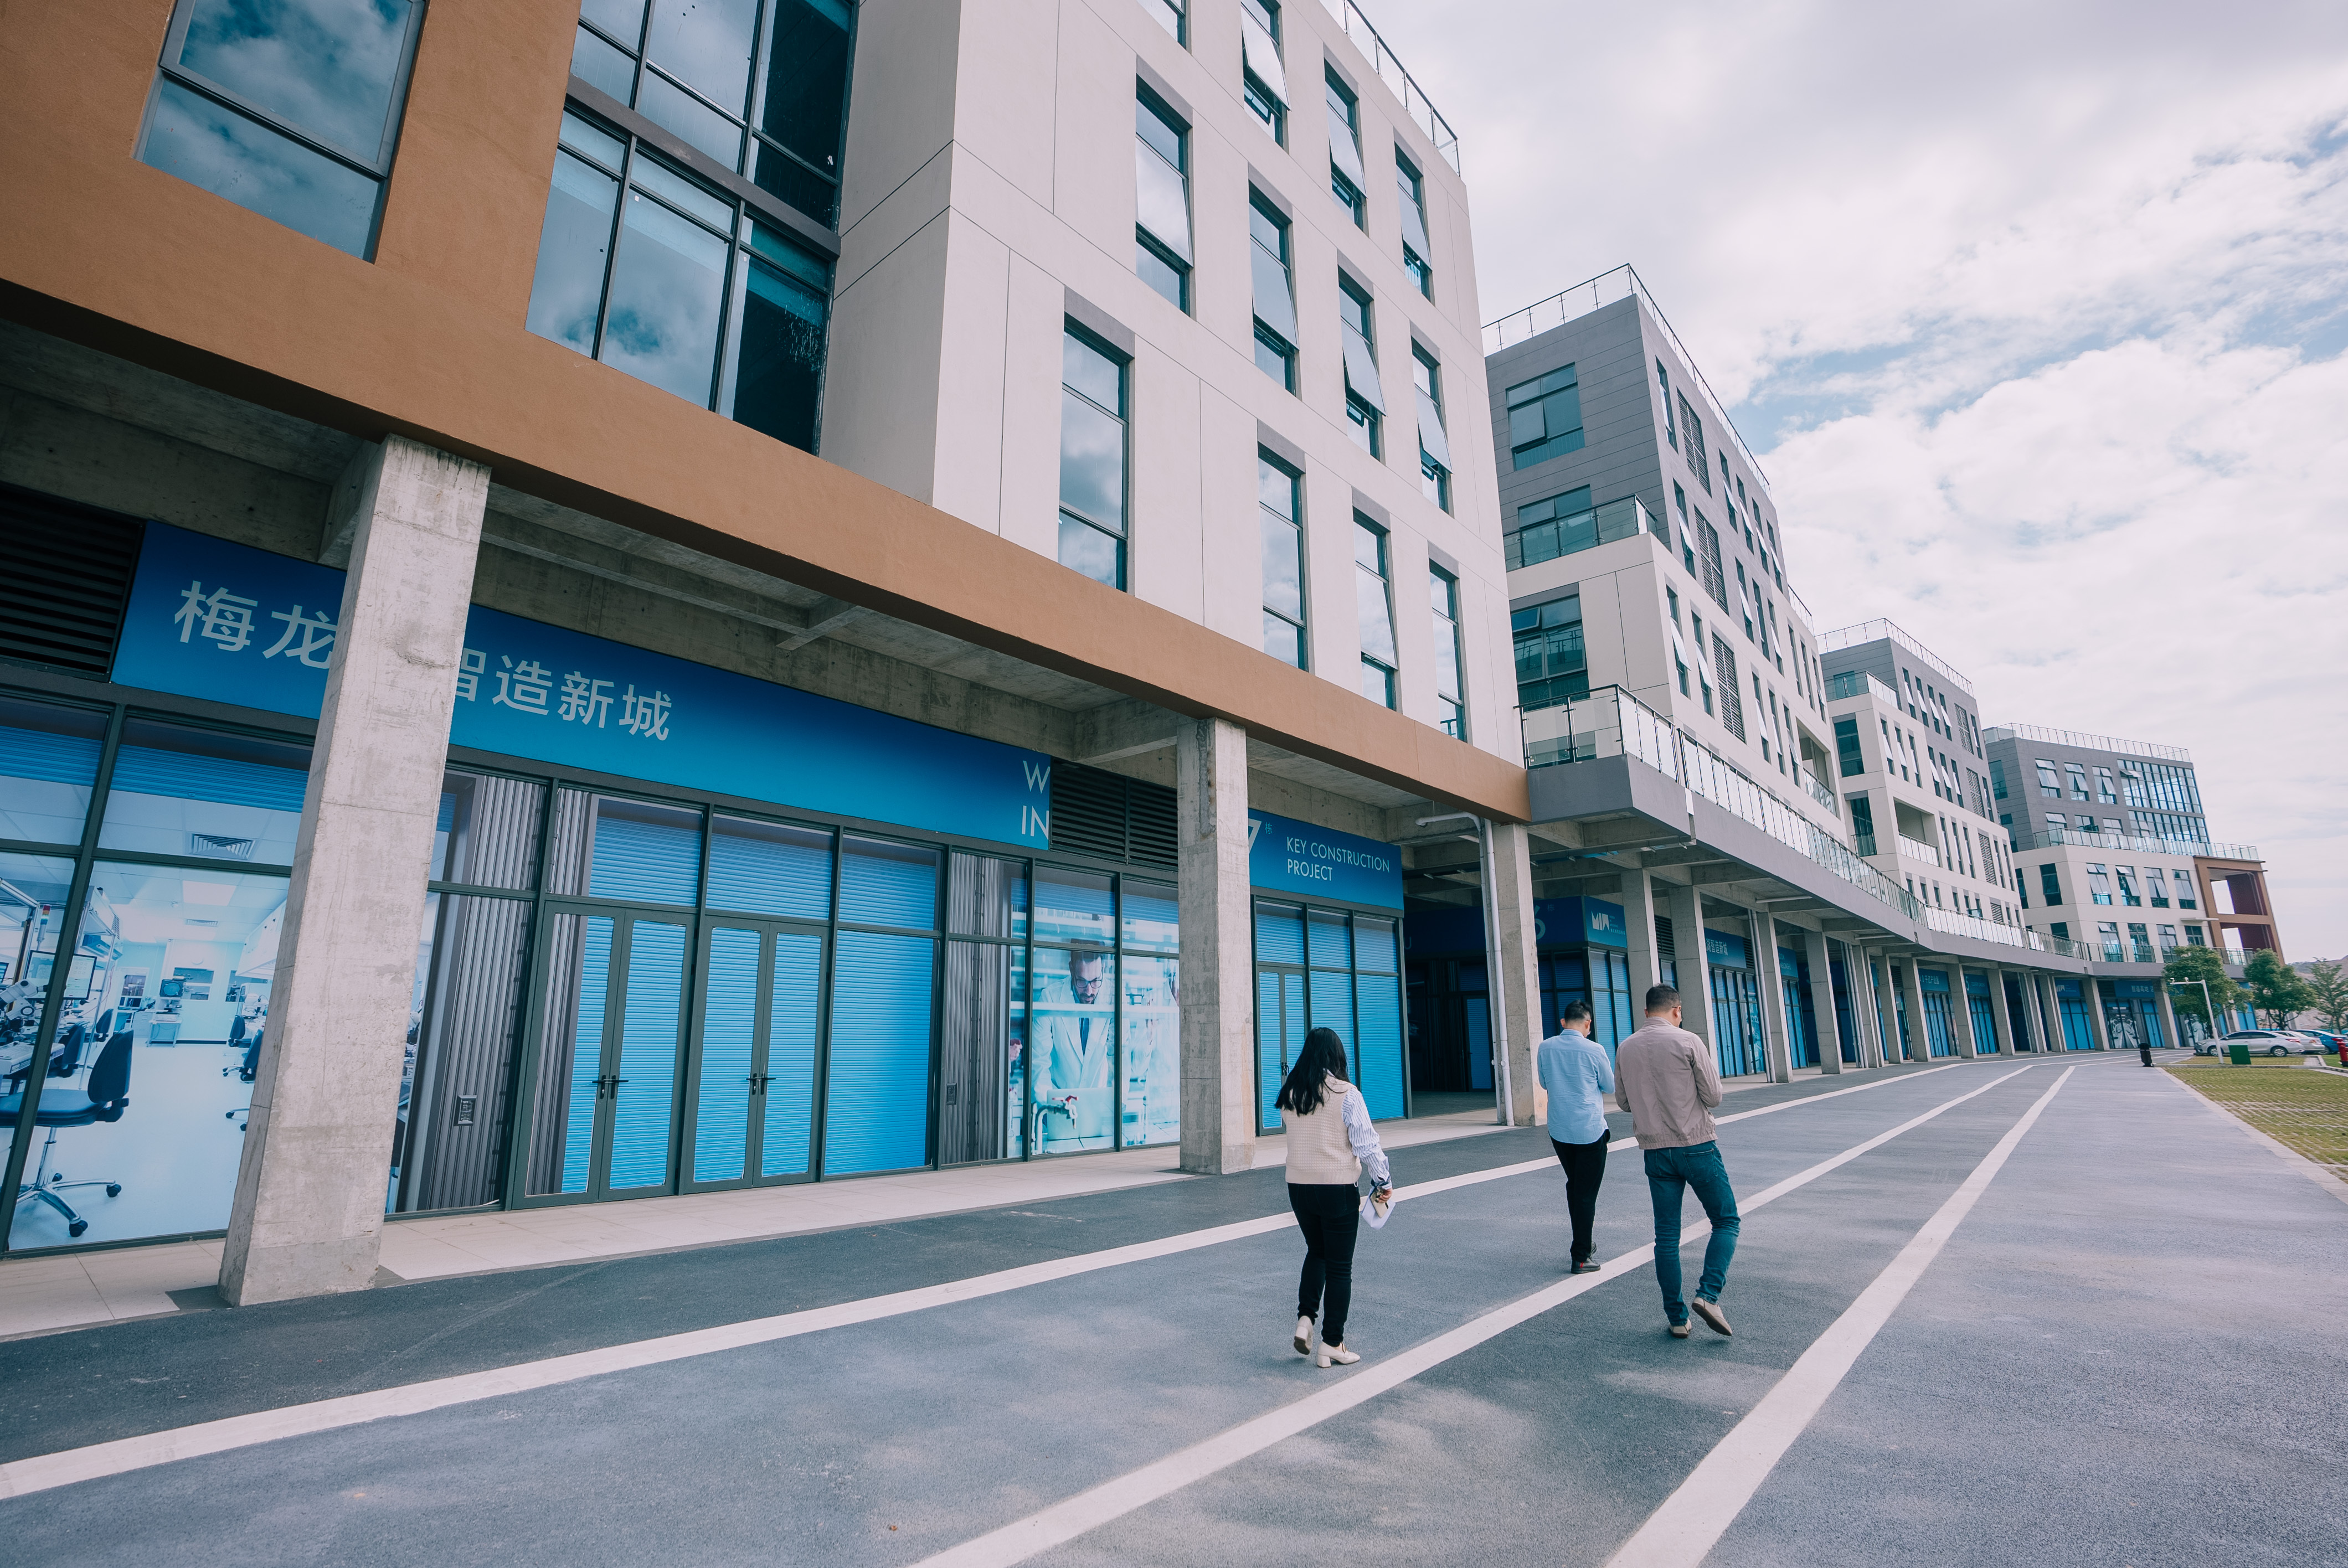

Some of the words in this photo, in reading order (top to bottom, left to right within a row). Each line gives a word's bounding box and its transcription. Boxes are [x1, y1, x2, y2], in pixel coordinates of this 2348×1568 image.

[174, 580, 337, 669] 梅龙
[1022, 805, 1049, 840] IN
[1264, 822, 1273, 834] 栋
[1286, 837, 1307, 854] KEY
[1311, 842, 1390, 873] CONSTRUCTION
[1288, 858, 1333, 881] PROJECT
